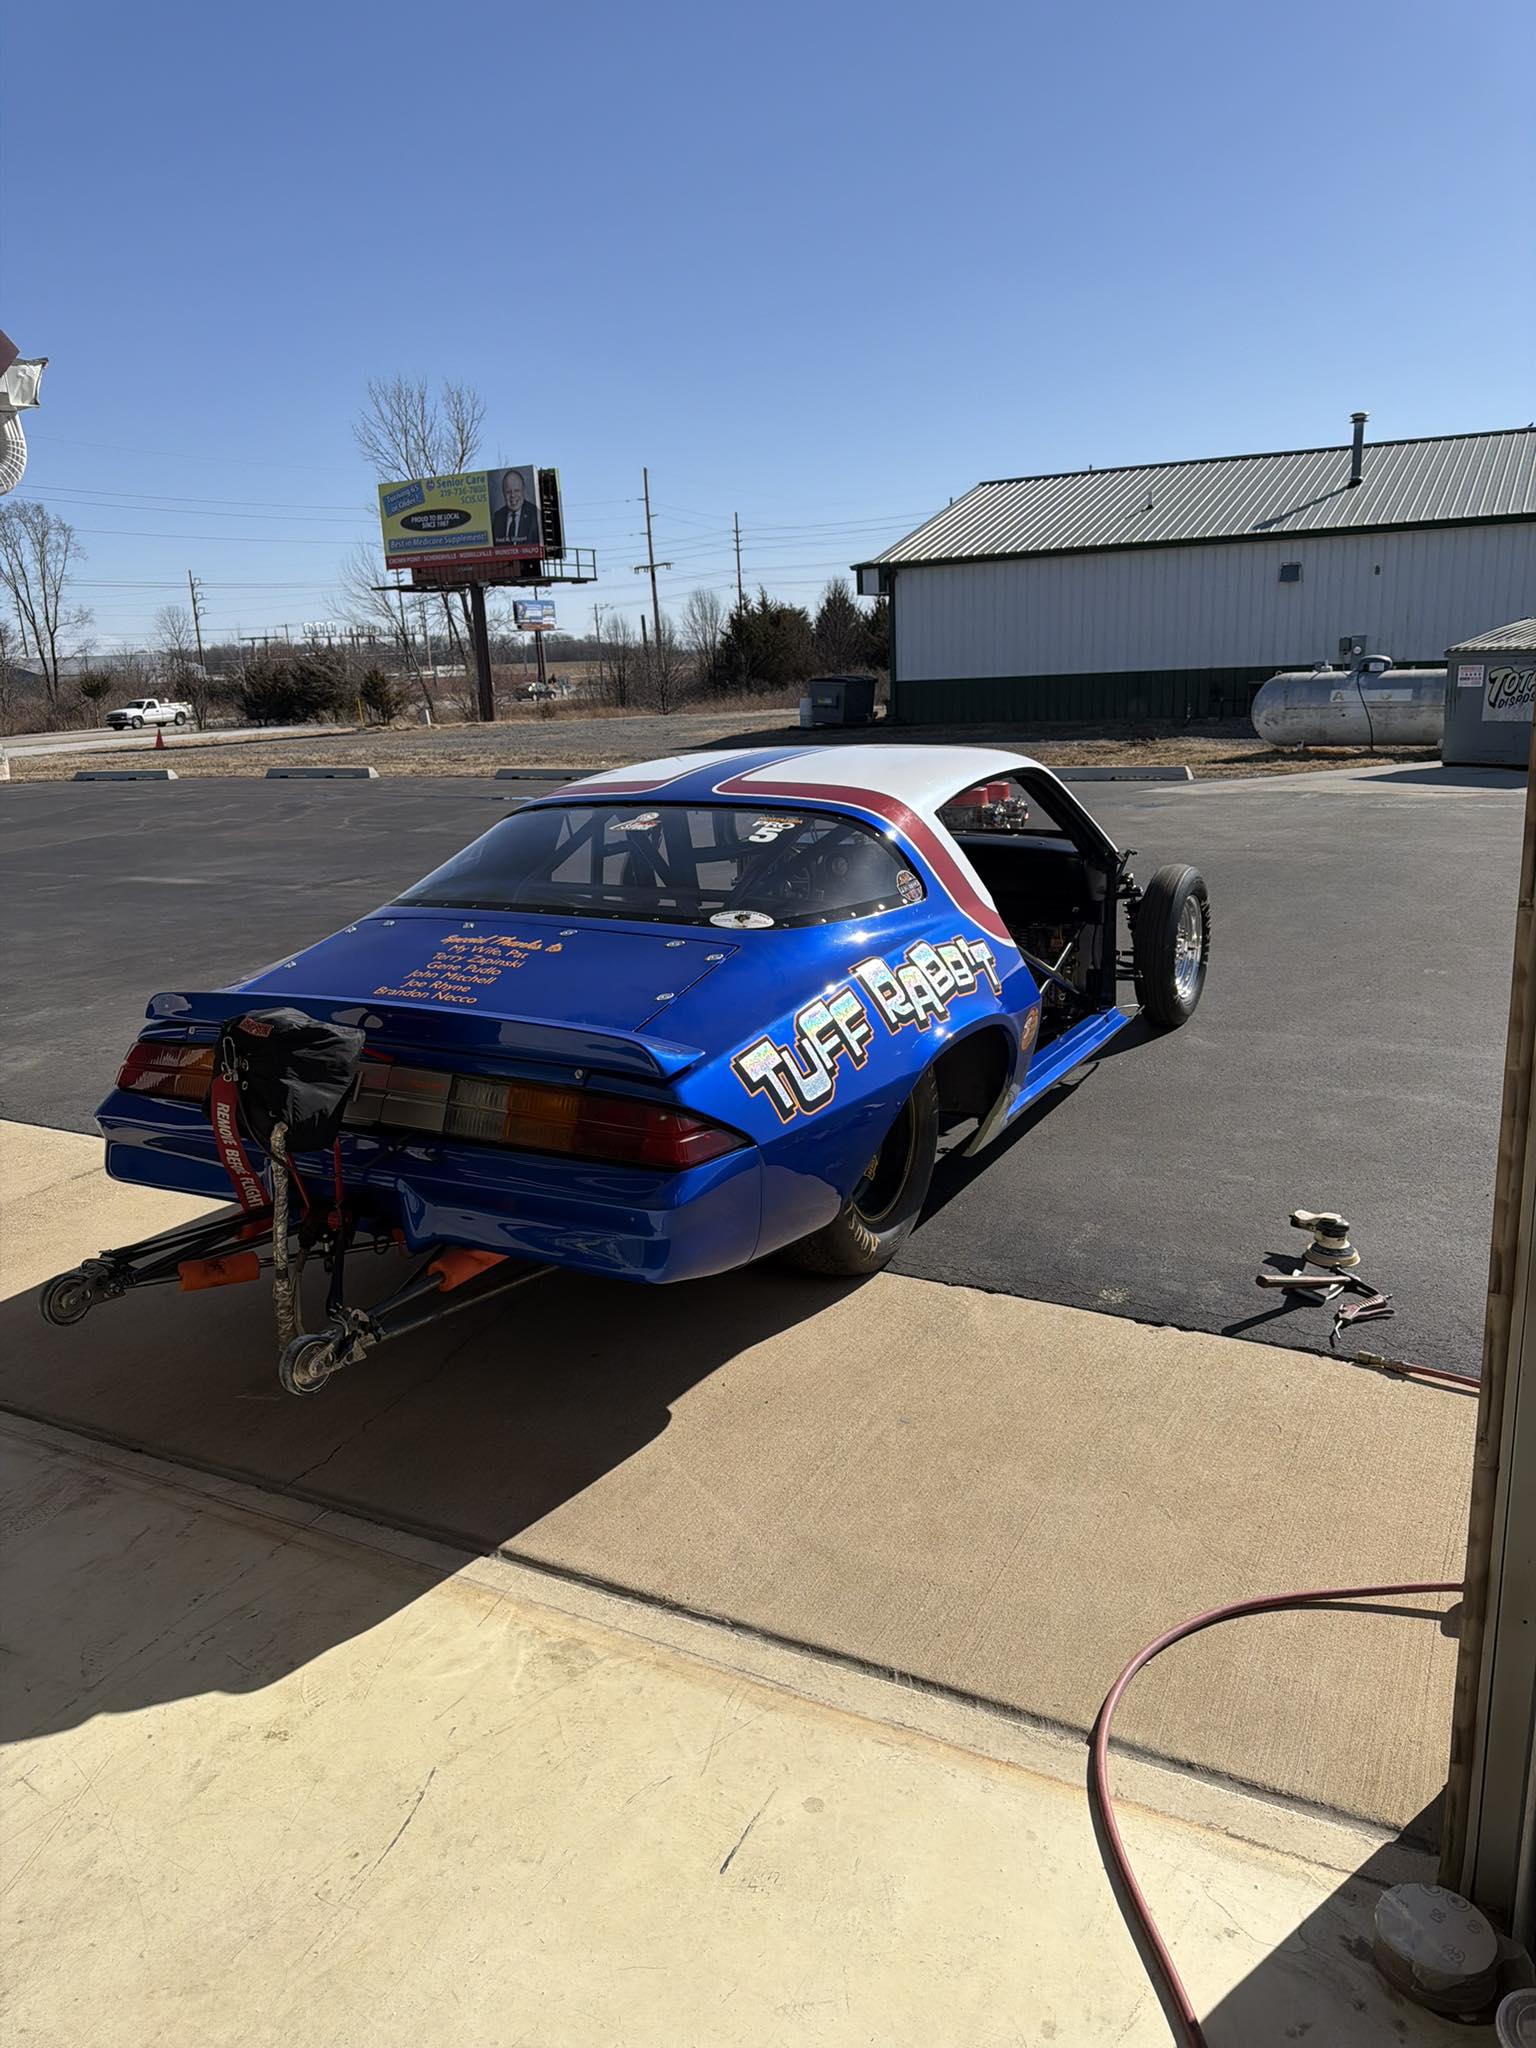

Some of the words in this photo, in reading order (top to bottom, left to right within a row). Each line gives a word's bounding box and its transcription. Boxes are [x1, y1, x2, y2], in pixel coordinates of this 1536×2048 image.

[436, 477, 464, 489] Senior
[466, 475, 485, 485] Care
[443, 512, 460, 520] LOCAL
[412, 537, 445, 547] Medicare
[752, 820, 796, 830] PRO
[749, 827, 784, 844] 5
[447, 944, 469, 954] My
[505, 949, 530, 959] Pat
[432, 952, 465, 963] Terry
[467, 954, 526, 969] Zapinski
[426, 961, 462, 971] Gene
[463, 964, 502, 976] Pudlo
[403, 969, 438, 980] John
[441, 971, 497, 985] Mitchell
[400, 978, 428, 989] Joe
[429, 980, 472, 993] Rhyne
[373, 986, 430, 999] Brandon
[432, 990, 478, 1004] Necco
[730, 986, 873, 1124] TUFF
[848, 935, 1003, 1036] RABBIT
[216, 1102, 238, 1146] REMOVE
[240, 1173, 265, 1208] FLIGHT
